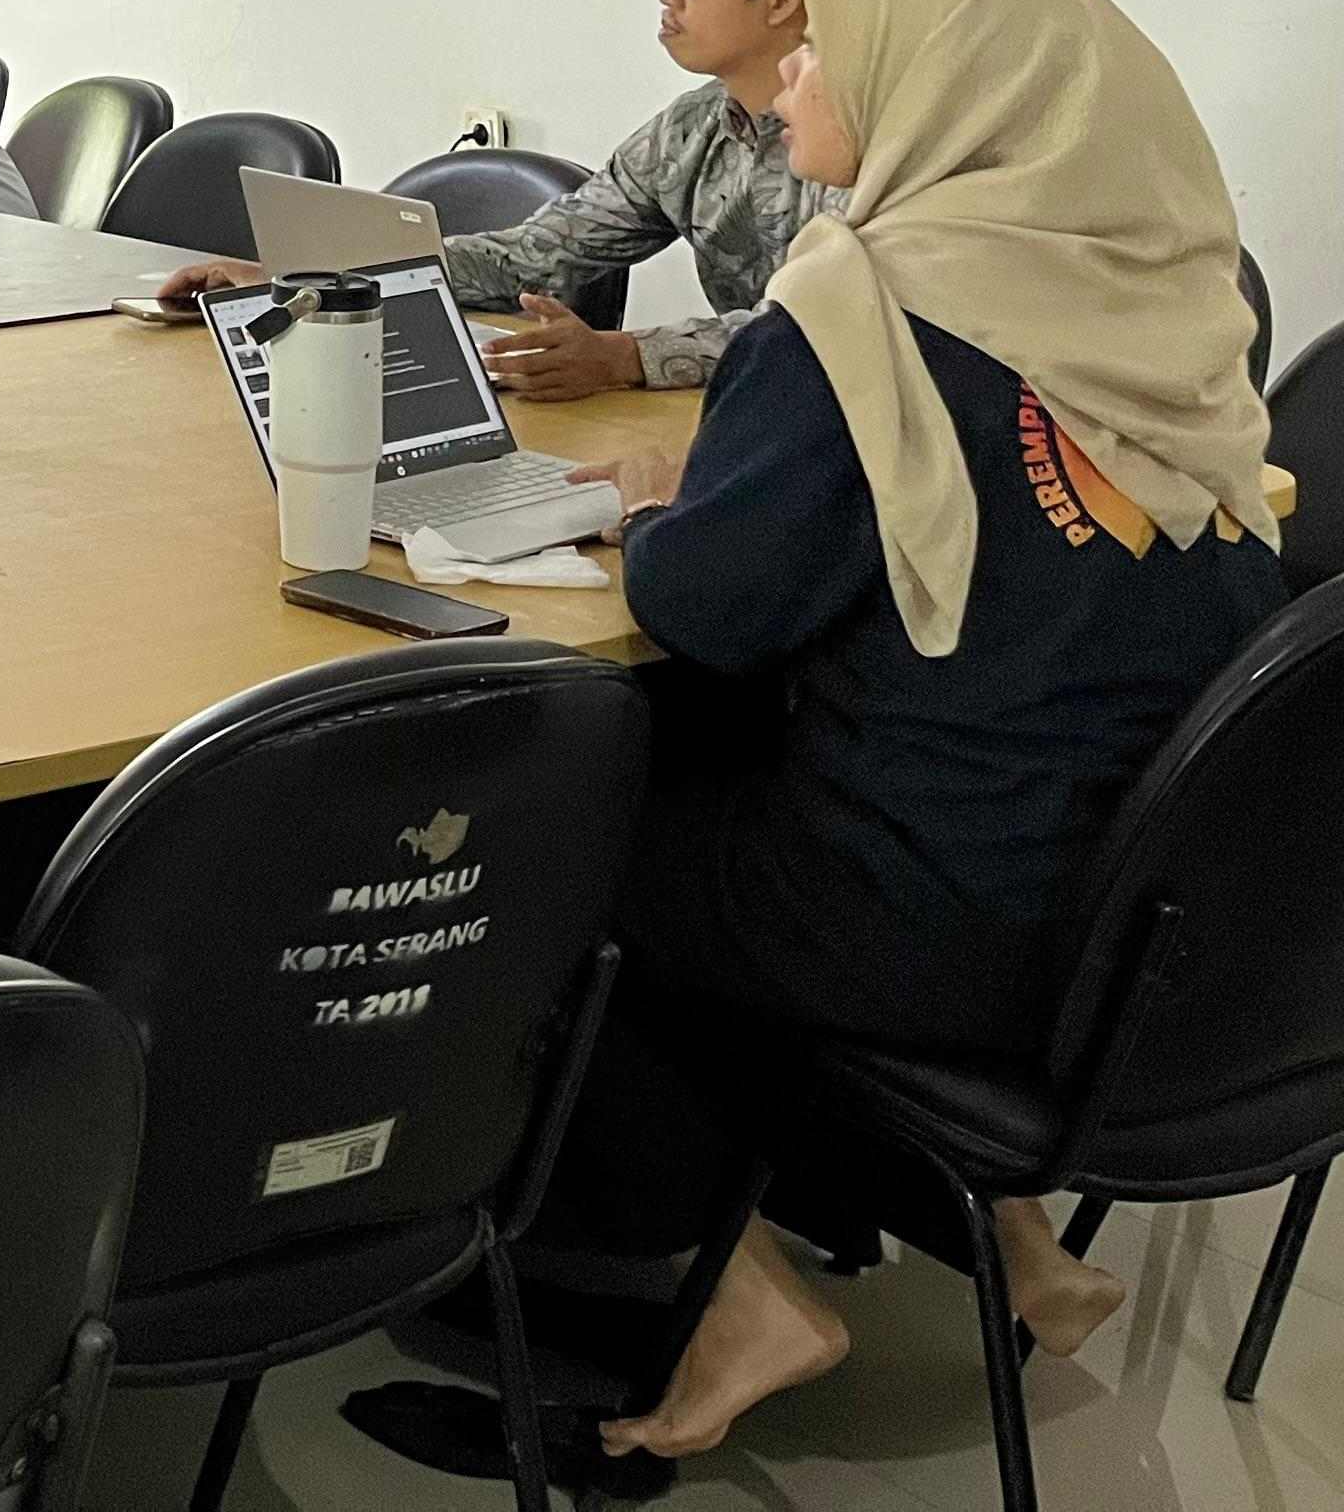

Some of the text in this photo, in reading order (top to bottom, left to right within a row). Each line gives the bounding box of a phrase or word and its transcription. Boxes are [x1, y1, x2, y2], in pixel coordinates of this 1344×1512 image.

[328, 864, 482, 914] BAWASLU
[279, 916, 490, 973] KOTA SERANG
[314, 998, 351, 1024] TA
